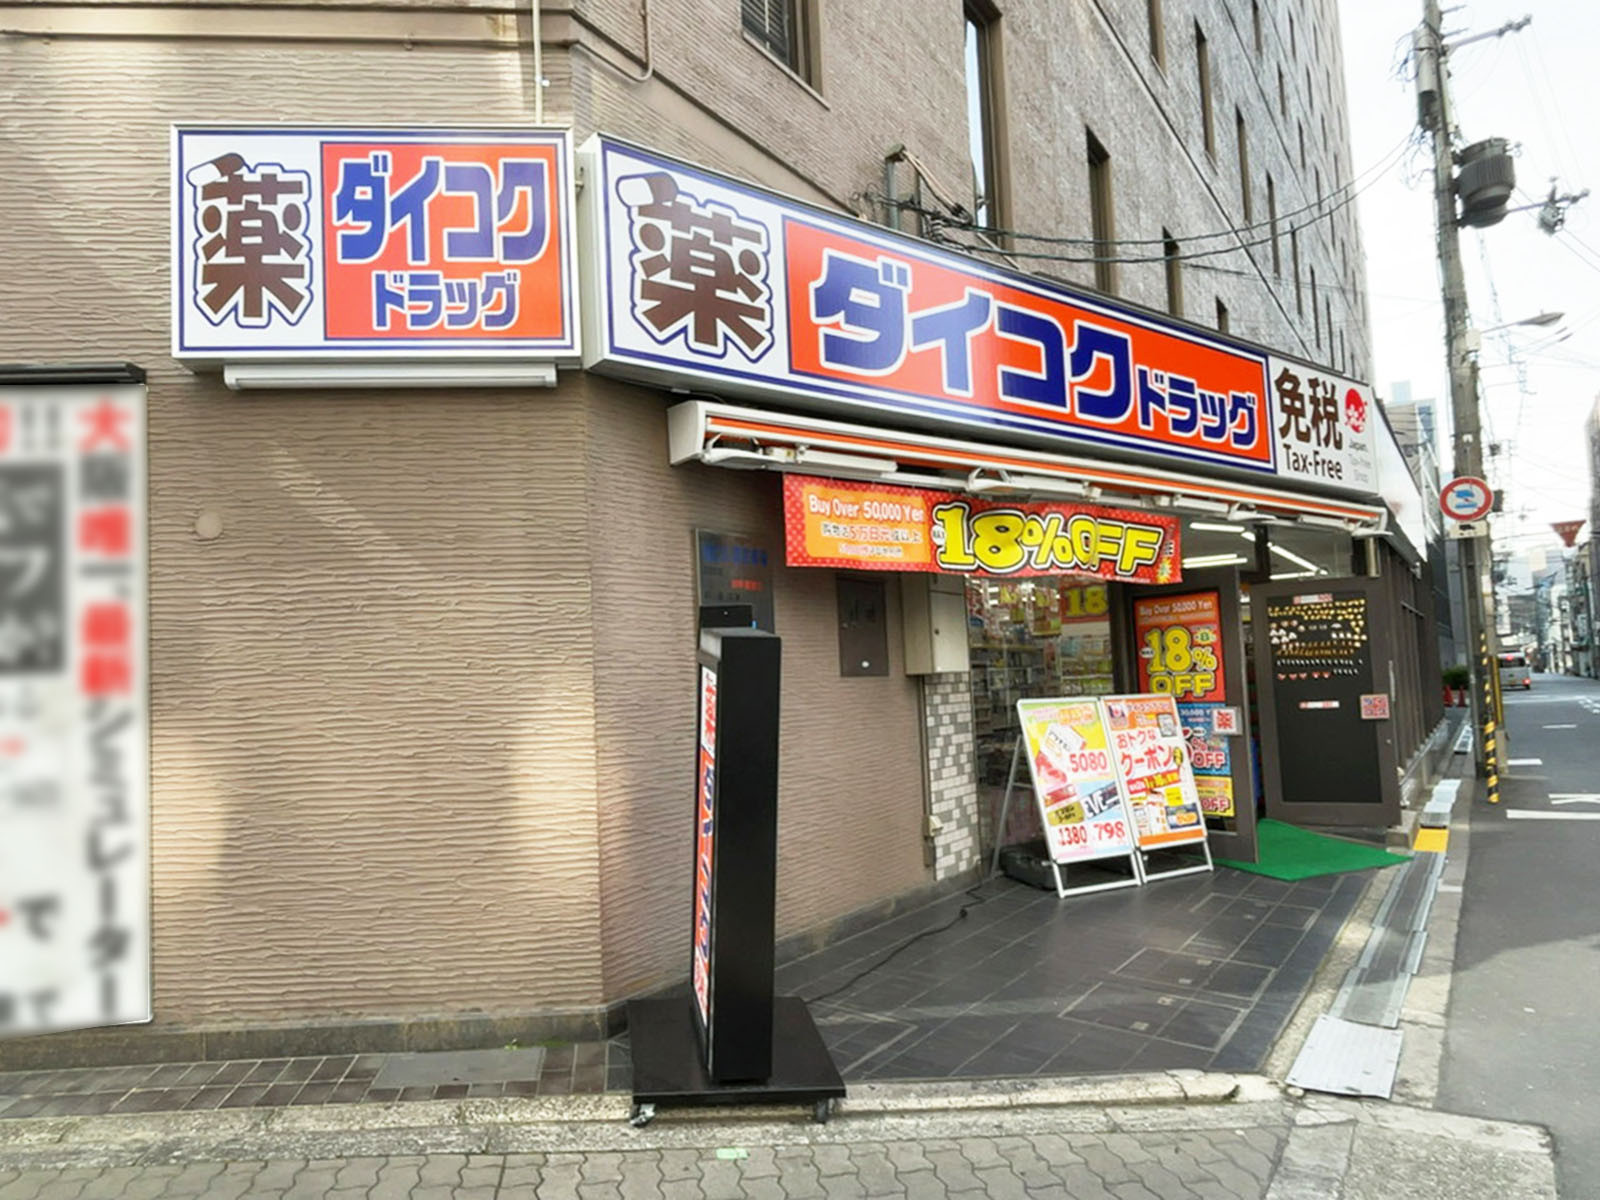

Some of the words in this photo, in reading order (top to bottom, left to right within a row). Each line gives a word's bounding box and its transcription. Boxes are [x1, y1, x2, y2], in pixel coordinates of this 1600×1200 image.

[331, 151, 549, 265] ダイコク
[189, 154, 306, 319] 薬
[619, 174, 771, 358] 薬
[371, 270, 520, 330] ドラッグ
[1274, 367, 1343, 451] 免税
[1283, 443, 1343, 480] Tax-Free
[808, 495, 831, 516] Buy
[832, 498, 859, 518] Over
[863, 501, 902, 522] 50,000
[1150, 672, 1214, 696] OFF
[1116, 729, 1157, 749] おトクな
[1069, 752, 1108, 773] 5080
[1121, 745, 1173, 777] クーポン
